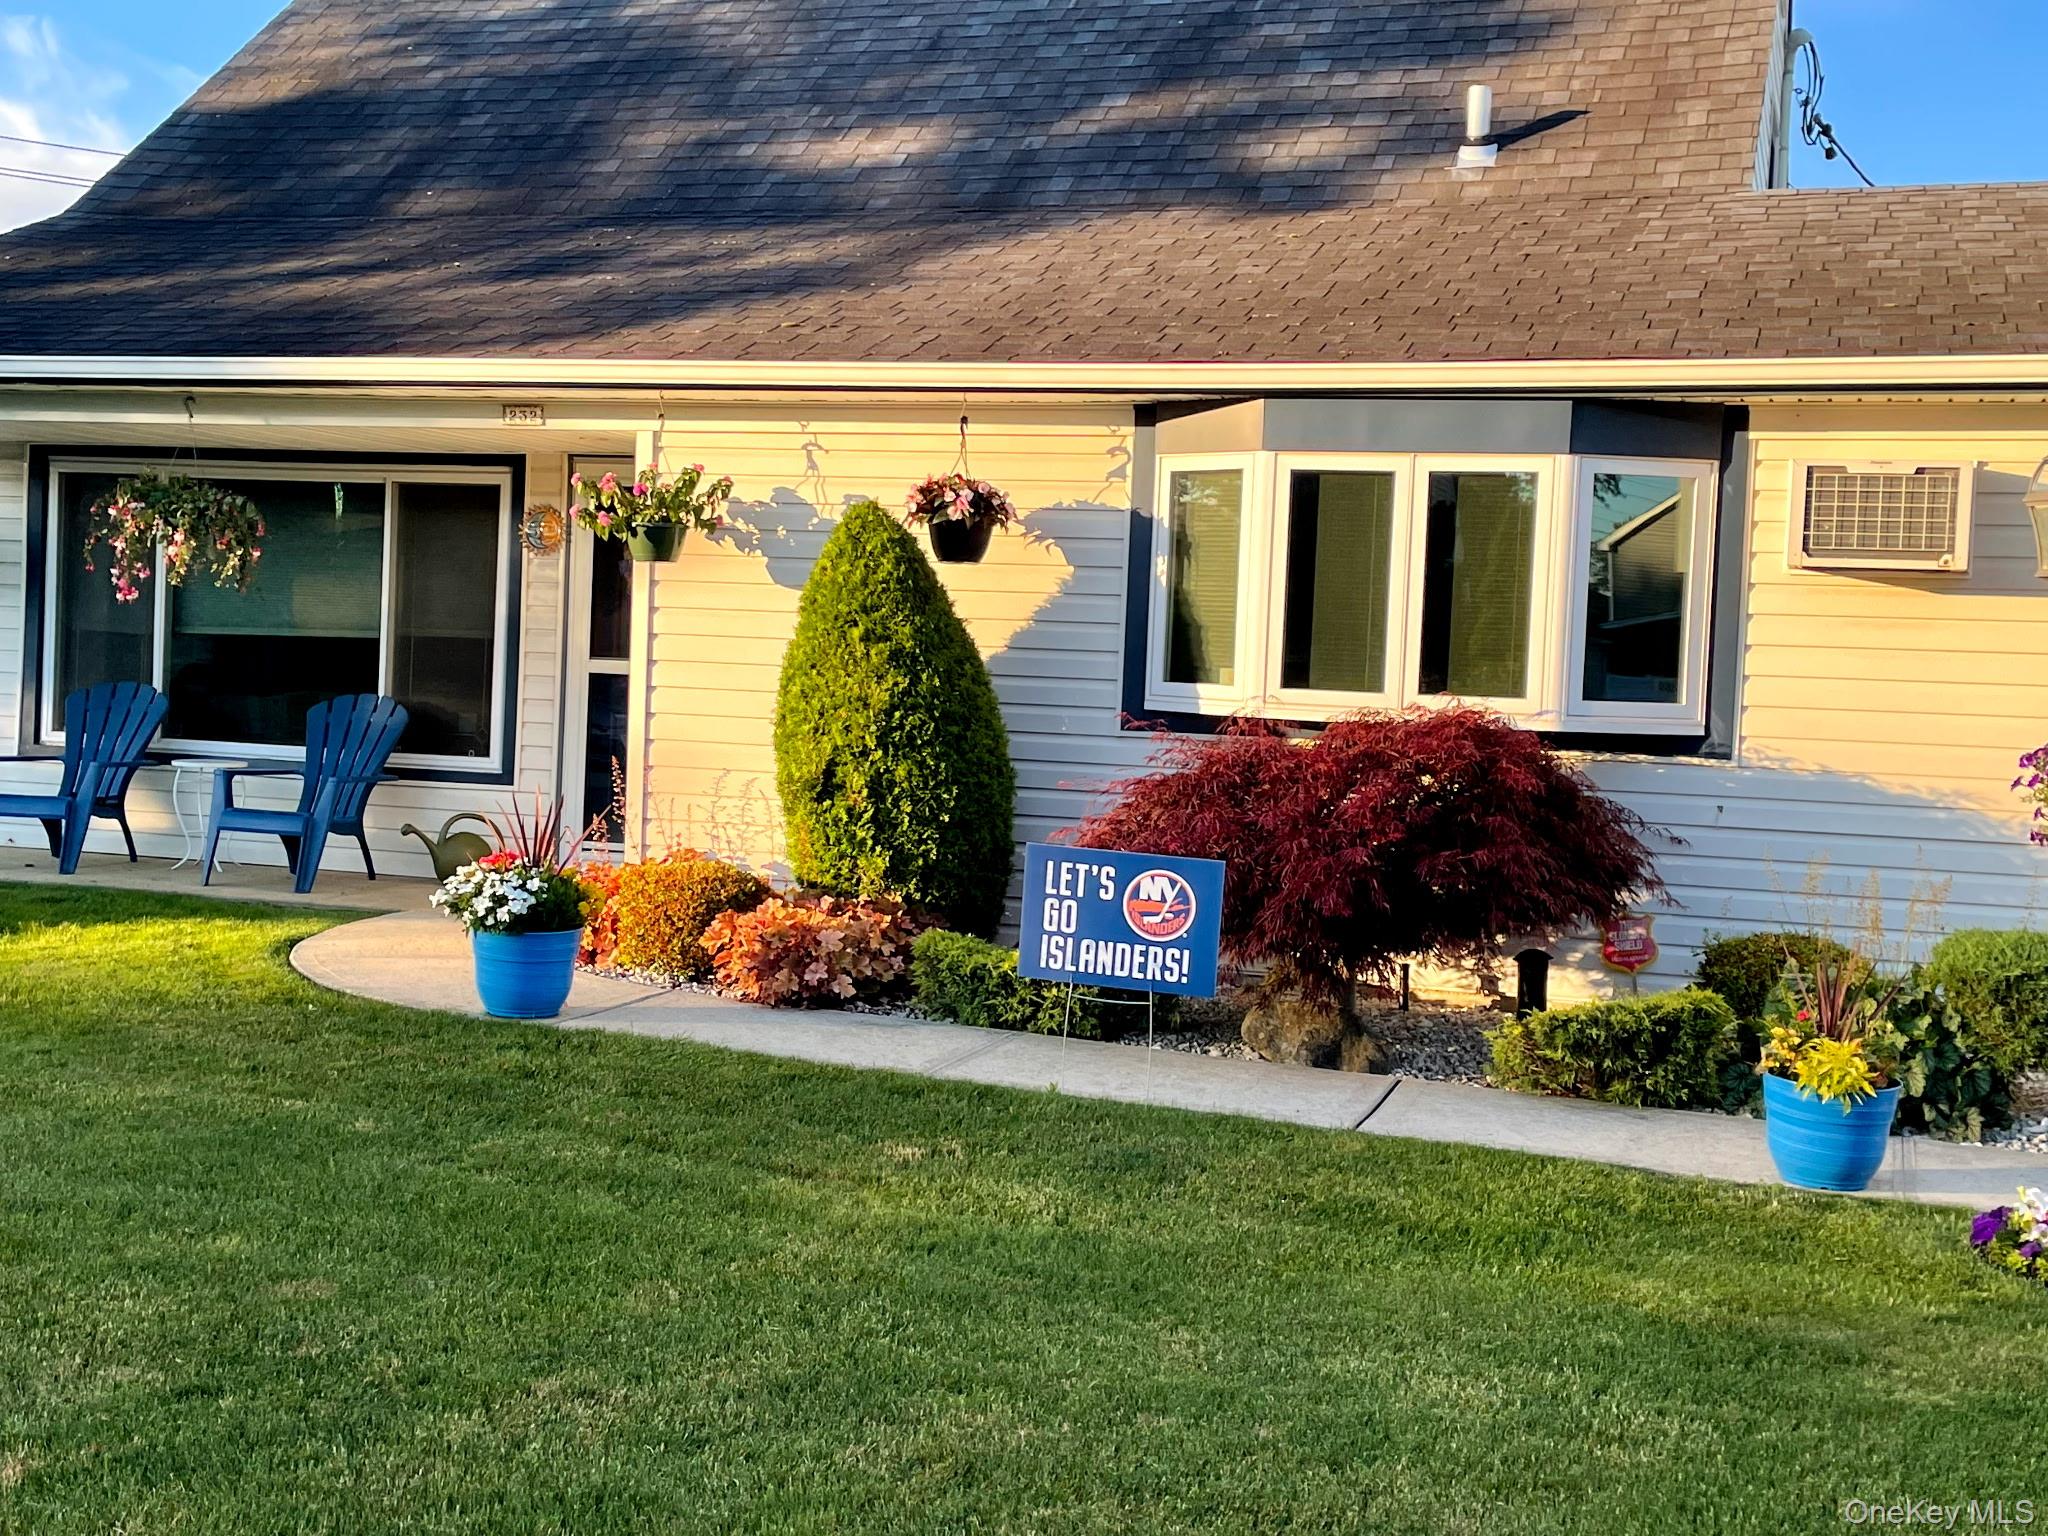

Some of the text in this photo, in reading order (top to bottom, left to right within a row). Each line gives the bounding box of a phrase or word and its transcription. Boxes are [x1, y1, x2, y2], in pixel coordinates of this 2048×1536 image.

[508, 409, 538, 421] 232
[1045, 860, 1116, 901] LET'S
[1139, 876, 1181, 908] NY
[1042, 897, 1078, 934] GO
[1039, 933, 1190, 984] ISLANDERS!
